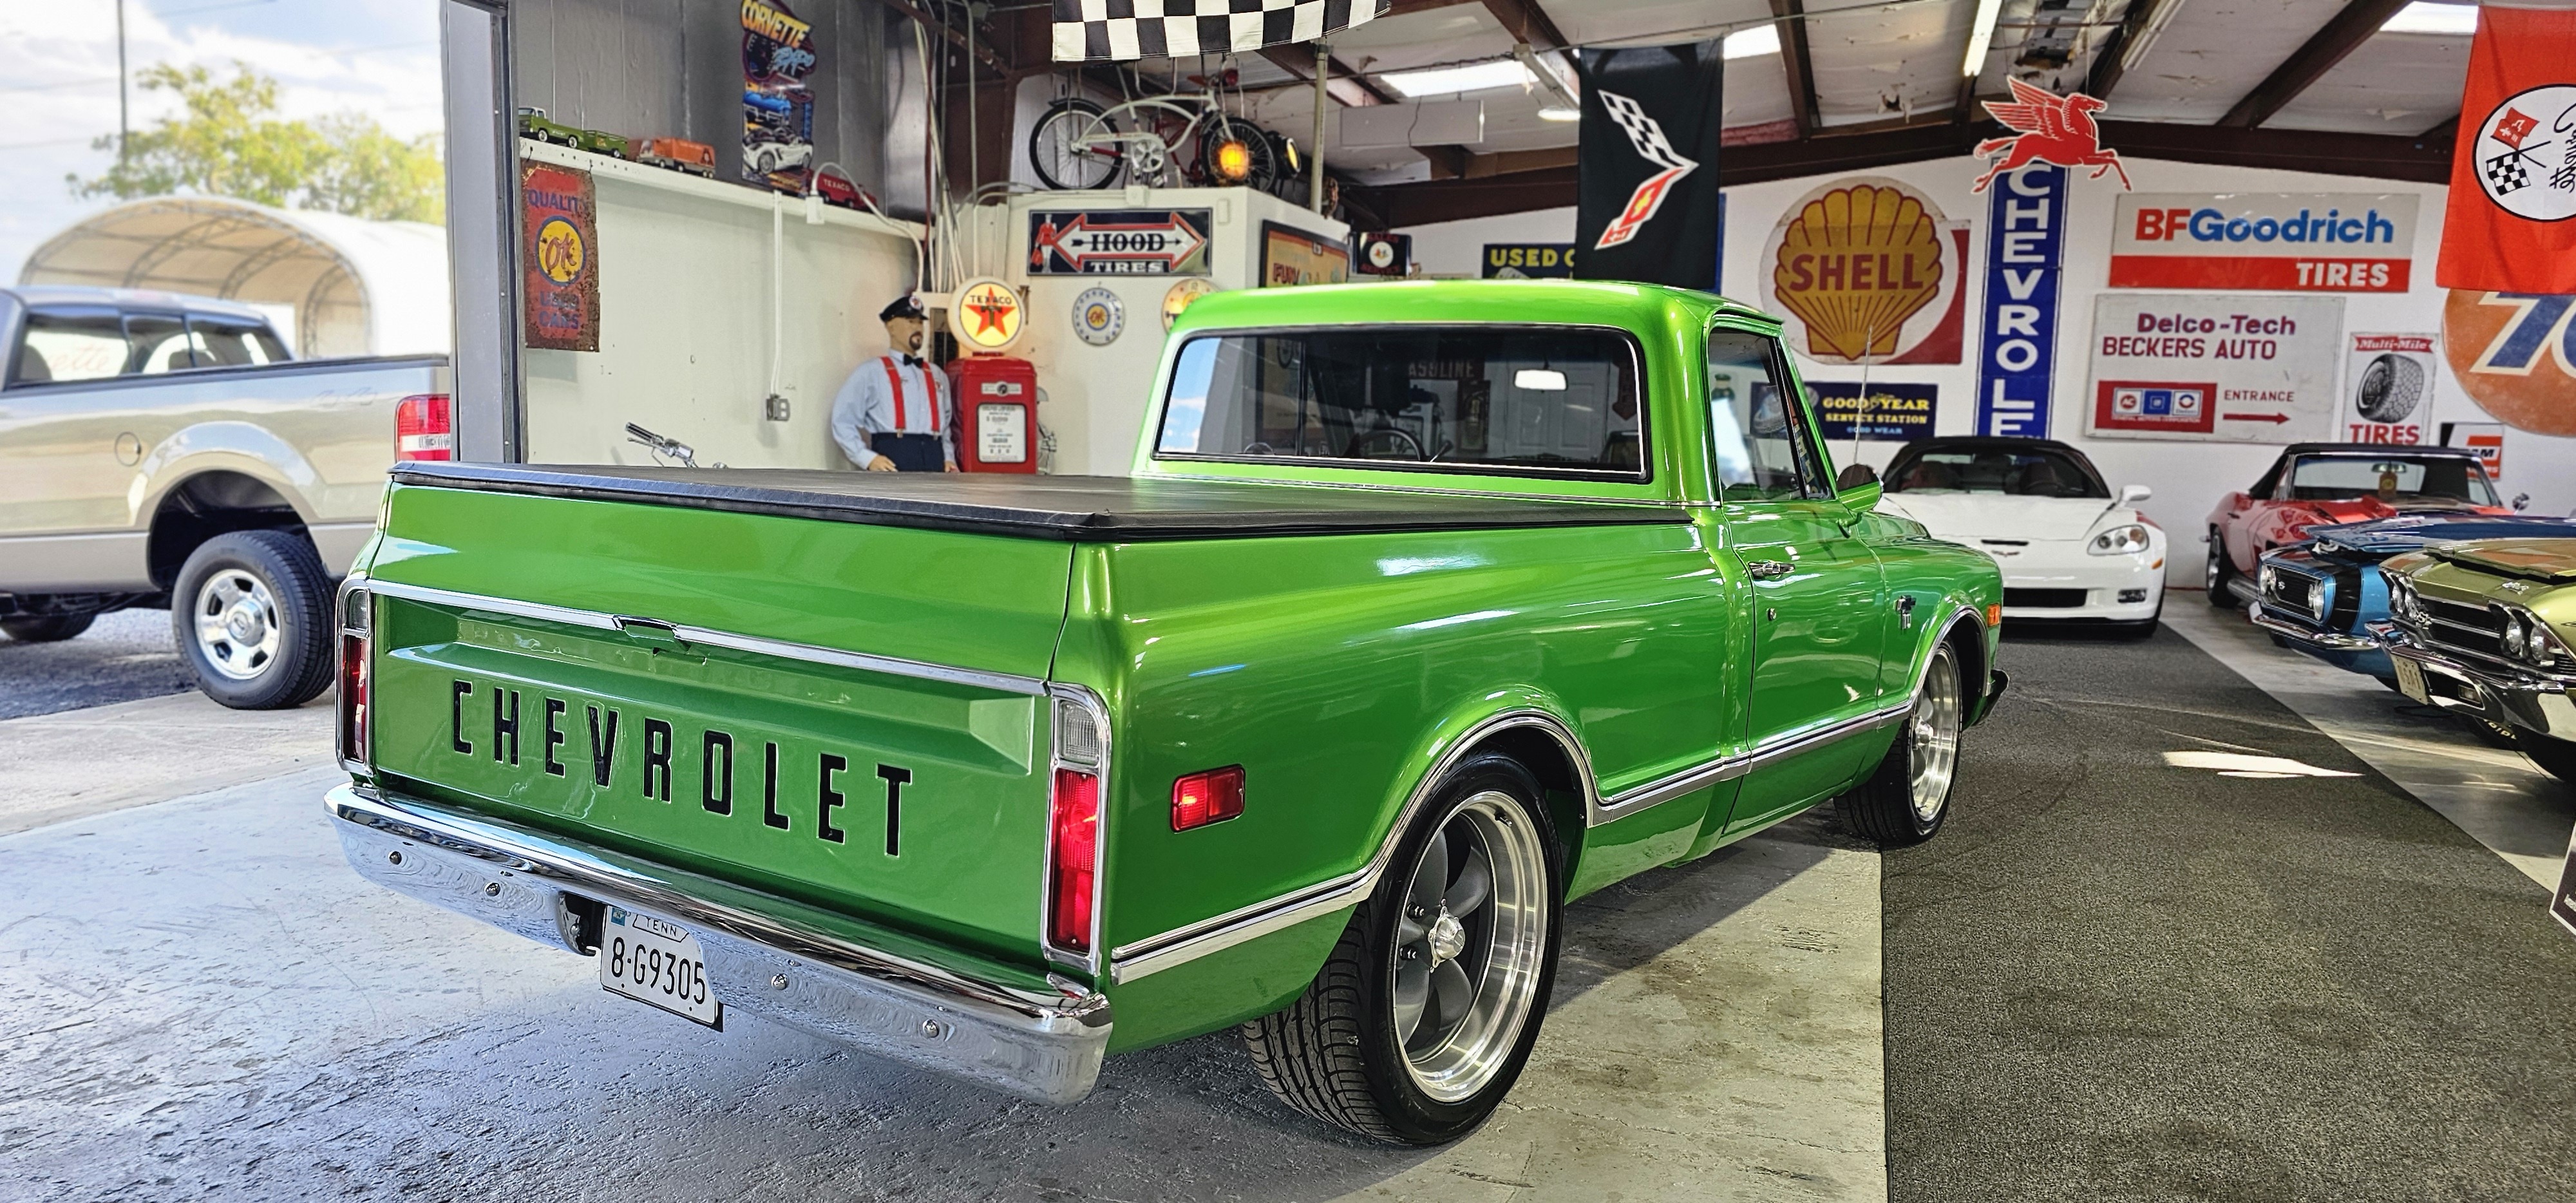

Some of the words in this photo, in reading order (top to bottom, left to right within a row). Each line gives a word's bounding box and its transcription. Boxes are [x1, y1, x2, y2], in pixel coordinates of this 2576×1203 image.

[741, 0, 811, 49] CORVETTE
[2135, 208, 2394, 244] BFGoodrich
[1091, 233, 1165, 252] HOOD
[1090, 261, 1162, 273] TIRES
[1490, 248, 1558, 267] USED
[1789, 253, 1924, 292] SHELL
[2296, 261, 2389, 288] TIRES
[970, 295, 1012, 305] TEXACO
[1991, 163, 2052, 438] CHEVROLE
[538, 311, 580, 329] CARS
[2359, 339, 2427, 350] Multi-Mile
[2469, 289, 2576, 379] 7
[2102, 336, 2205, 358] BECKERS
[2215, 339, 2277, 360] AUTO
[1408, 361, 1474, 377] ASOLINE
[2224, 389, 2295, 402] ENTRANCE
[1826, 413, 1873, 422] SERVICE
[1877, 415, 1927, 424] STATION
[2349, 424, 2420, 445] TIRES
[452, 680, 913, 857] CHEVROLET
[646, 916, 677, 937] TENN
